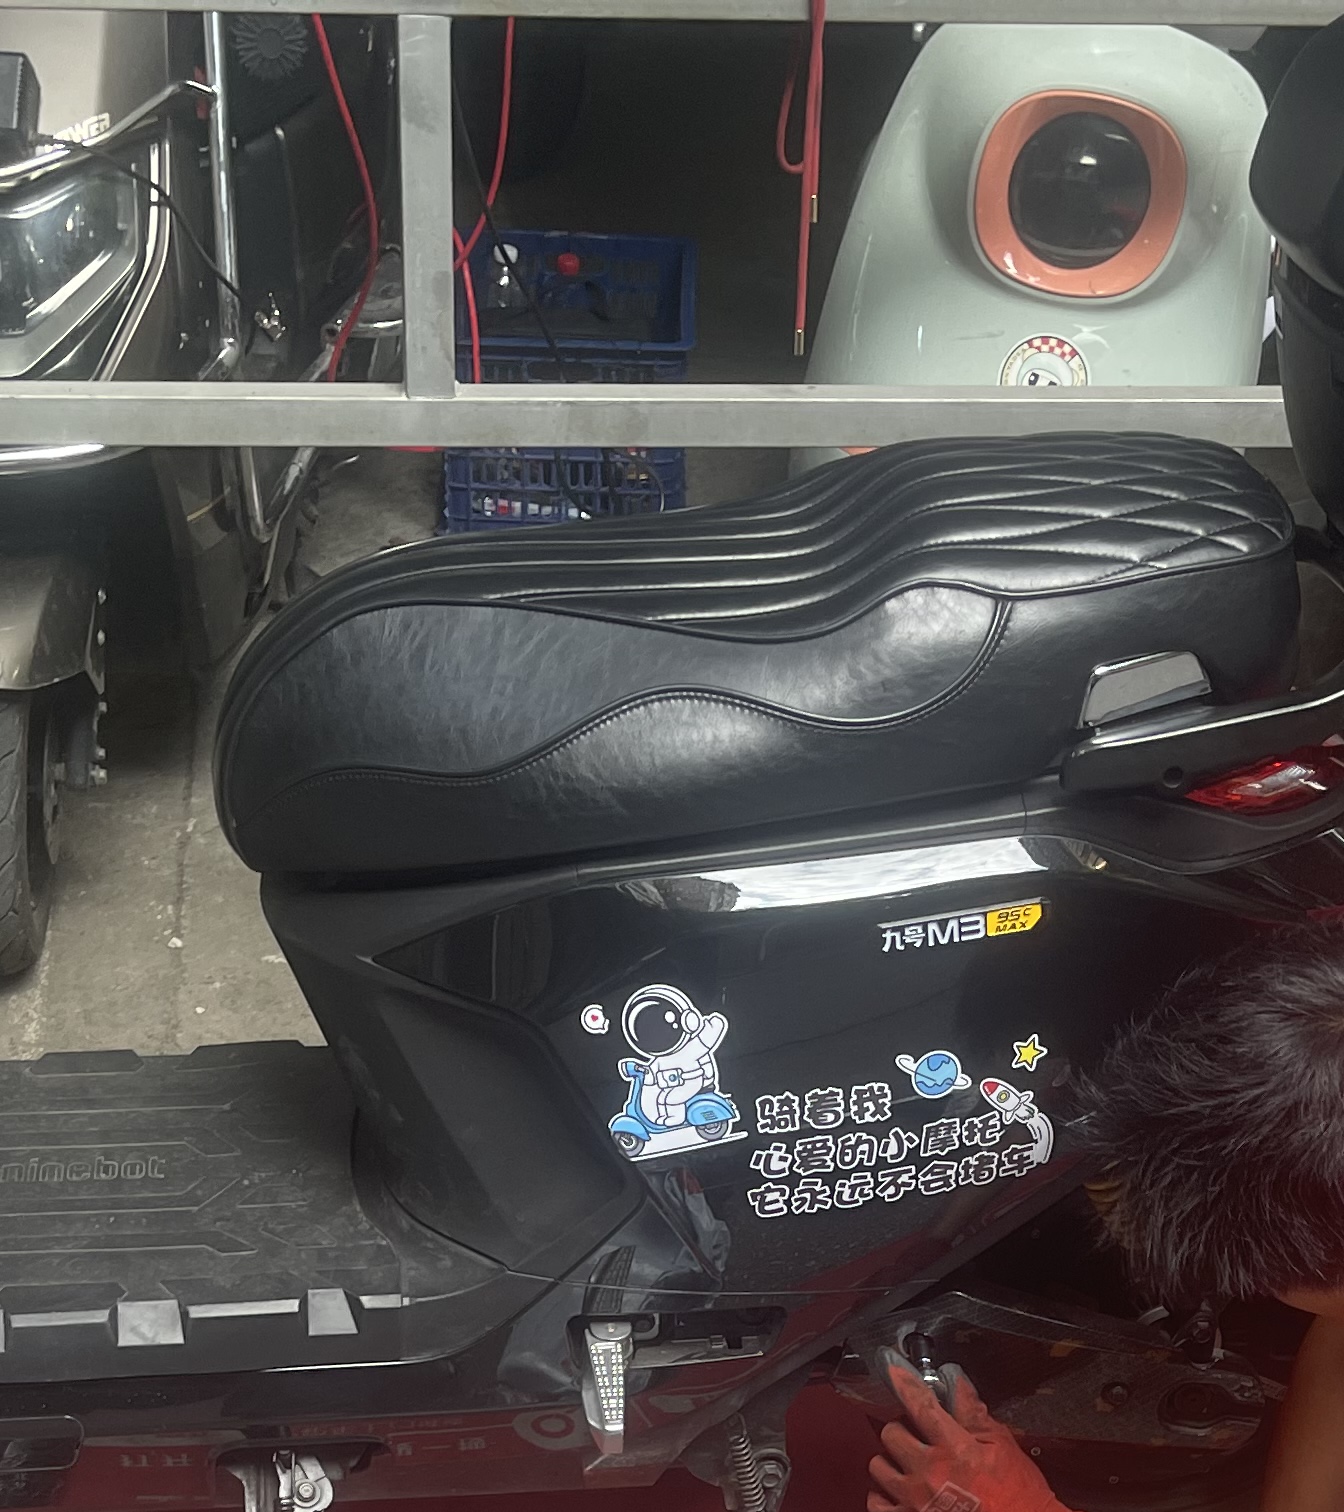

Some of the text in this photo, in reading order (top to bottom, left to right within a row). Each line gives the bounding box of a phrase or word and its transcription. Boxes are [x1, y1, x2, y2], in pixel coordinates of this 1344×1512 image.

[994, 920, 1029, 934] MAX
[756, 1082, 894, 1133] 骑着我
[750, 1111, 1003, 1179] 心爱的小摩托
[748, 1142, 1040, 1218] 它永远不会堵车
